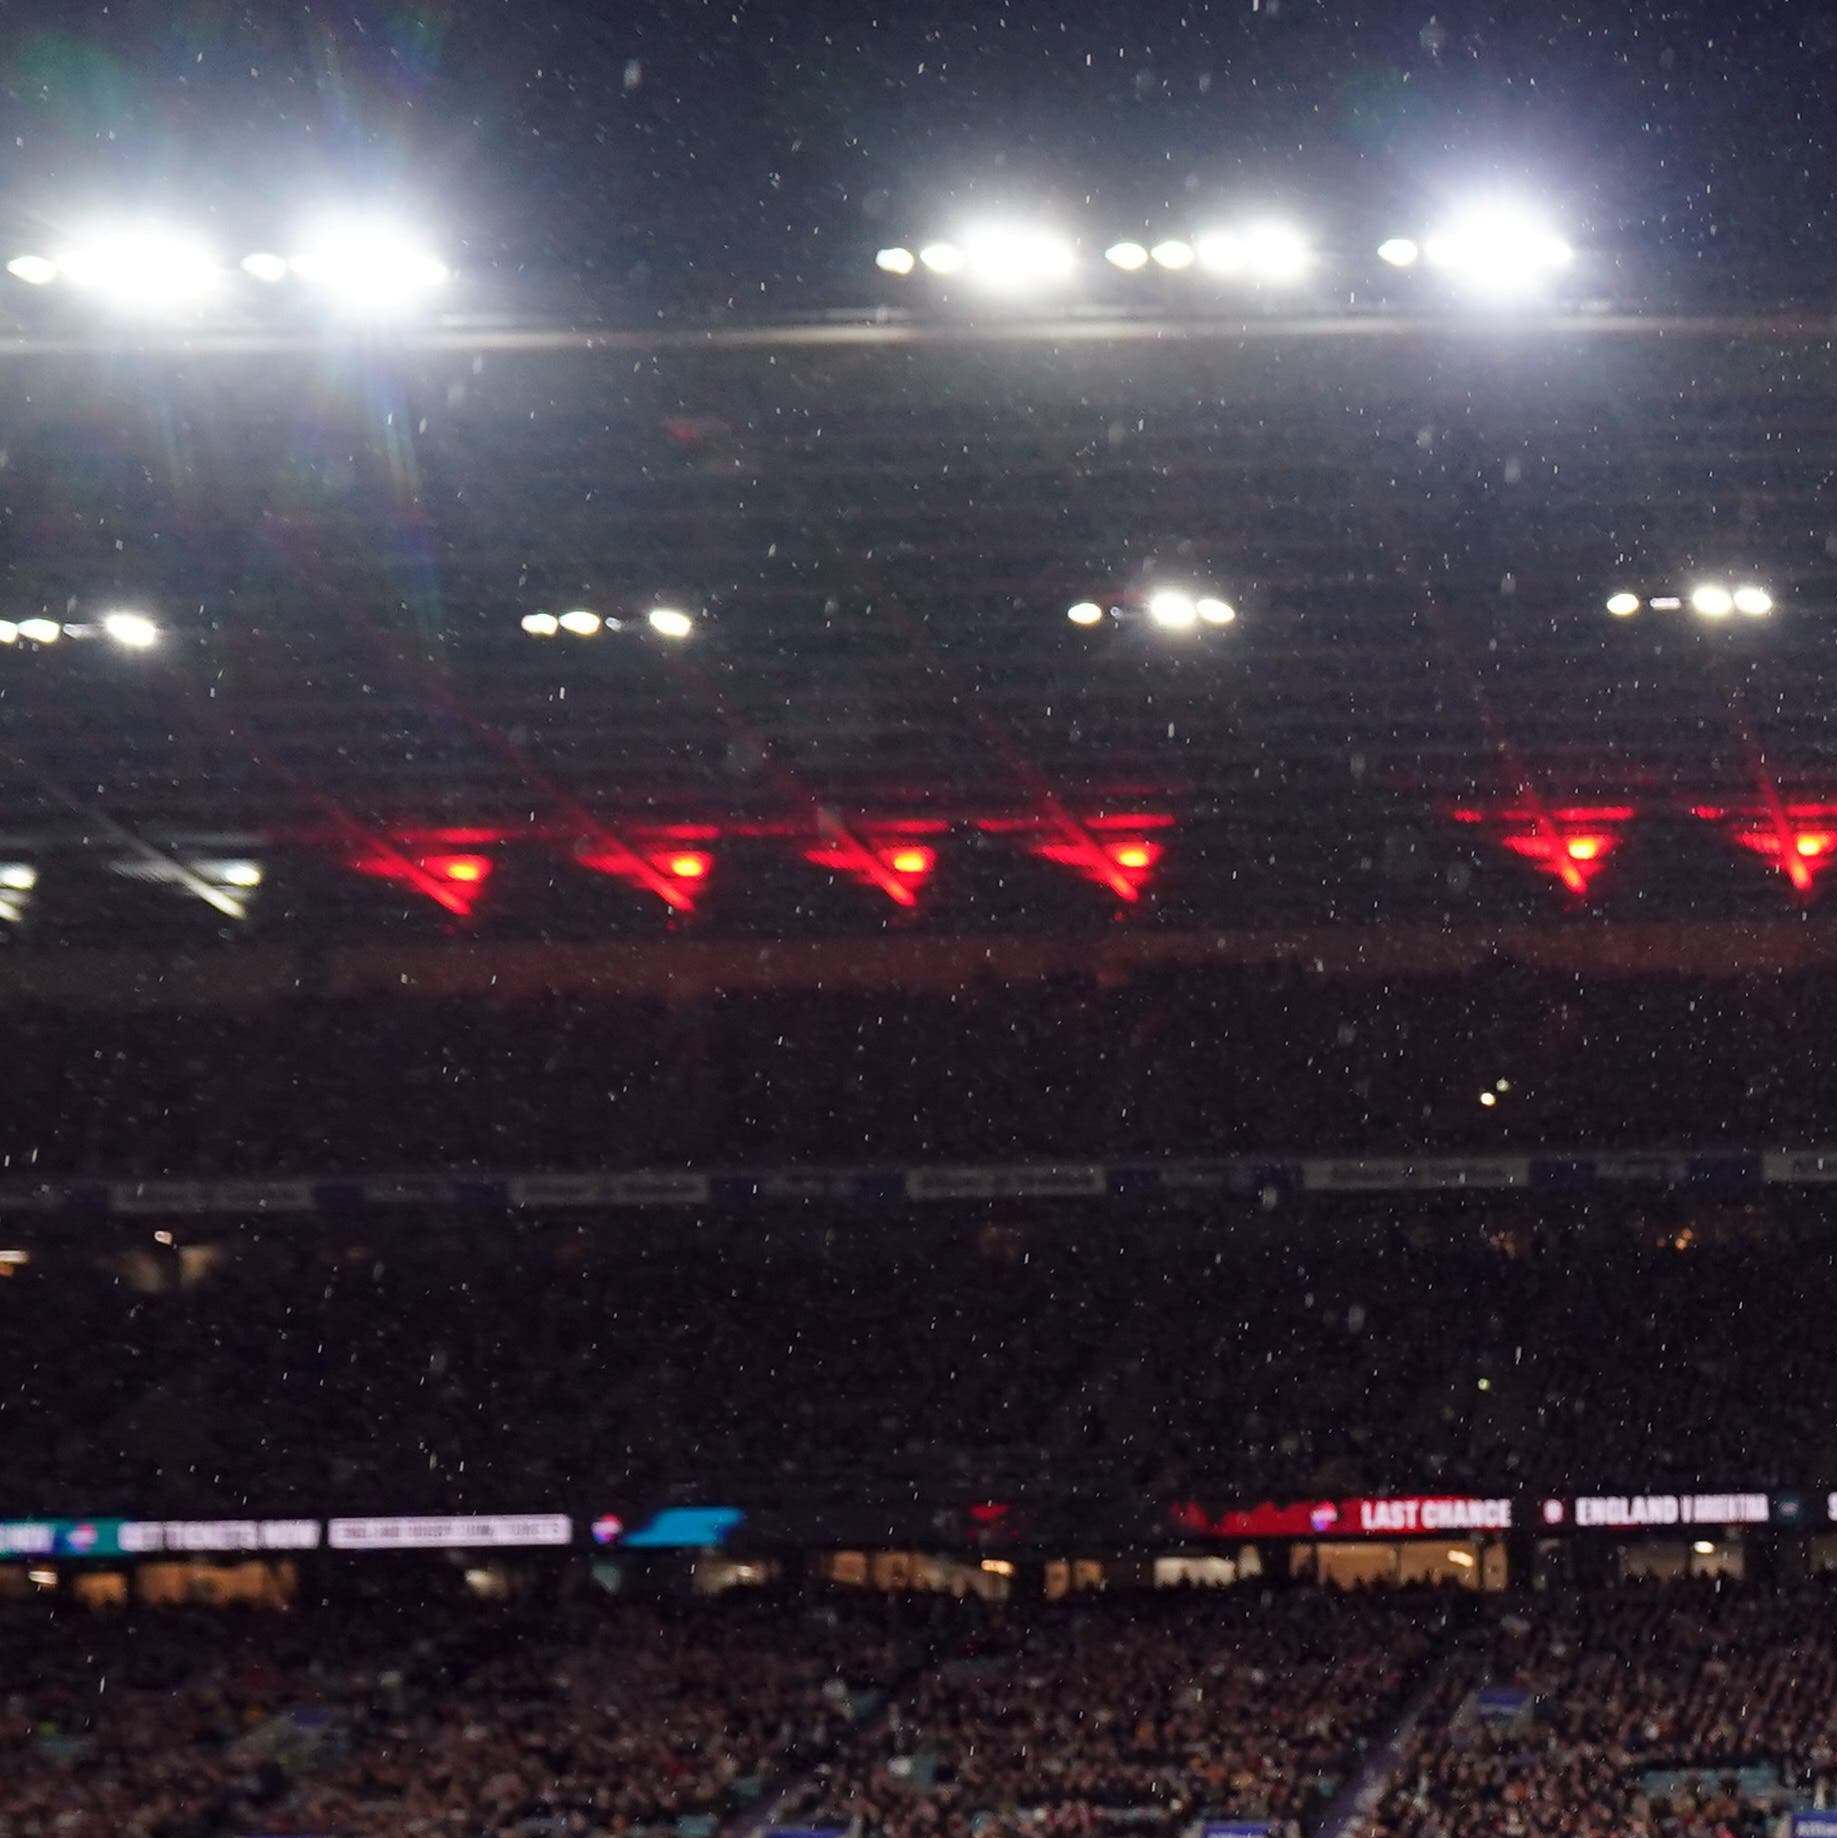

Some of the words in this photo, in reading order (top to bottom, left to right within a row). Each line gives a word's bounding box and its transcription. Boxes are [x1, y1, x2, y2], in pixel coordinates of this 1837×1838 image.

[1361, 1498, 1420, 1530] LAST
[1421, 1497, 1512, 1529] CHANCE
[1575, 1496, 1679, 1526] ENGLAND
